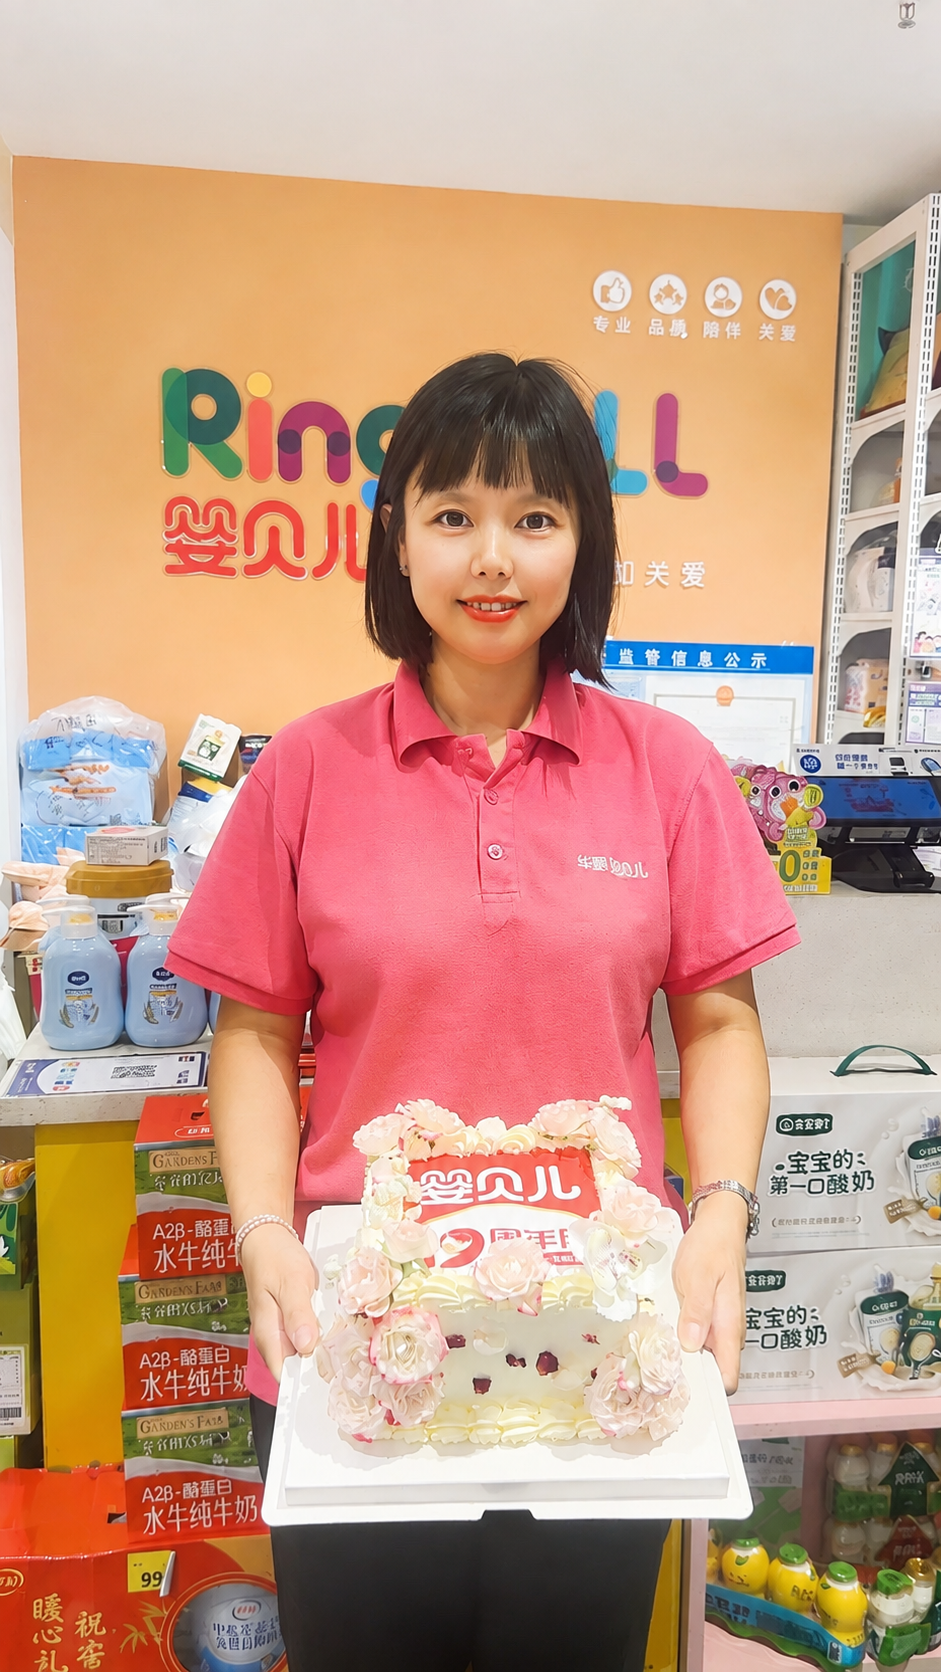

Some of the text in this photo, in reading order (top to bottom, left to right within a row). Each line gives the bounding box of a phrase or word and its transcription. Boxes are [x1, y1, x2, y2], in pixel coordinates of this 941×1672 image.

[593, 316, 796, 342] 专业 品质 陪伴 关爱
[164, 496, 366, 583] 婴贝儿
[787, 1149, 853, 1175] 宝宝的
[420, 1165, 582, 1206] 婴贝儿
[769, 1170, 875, 1195] 第一口酸奶
[141, 1363, 248, 1401] 水牛纯牛奶
[143, 1495, 257, 1536] 水牛纯牛奶
